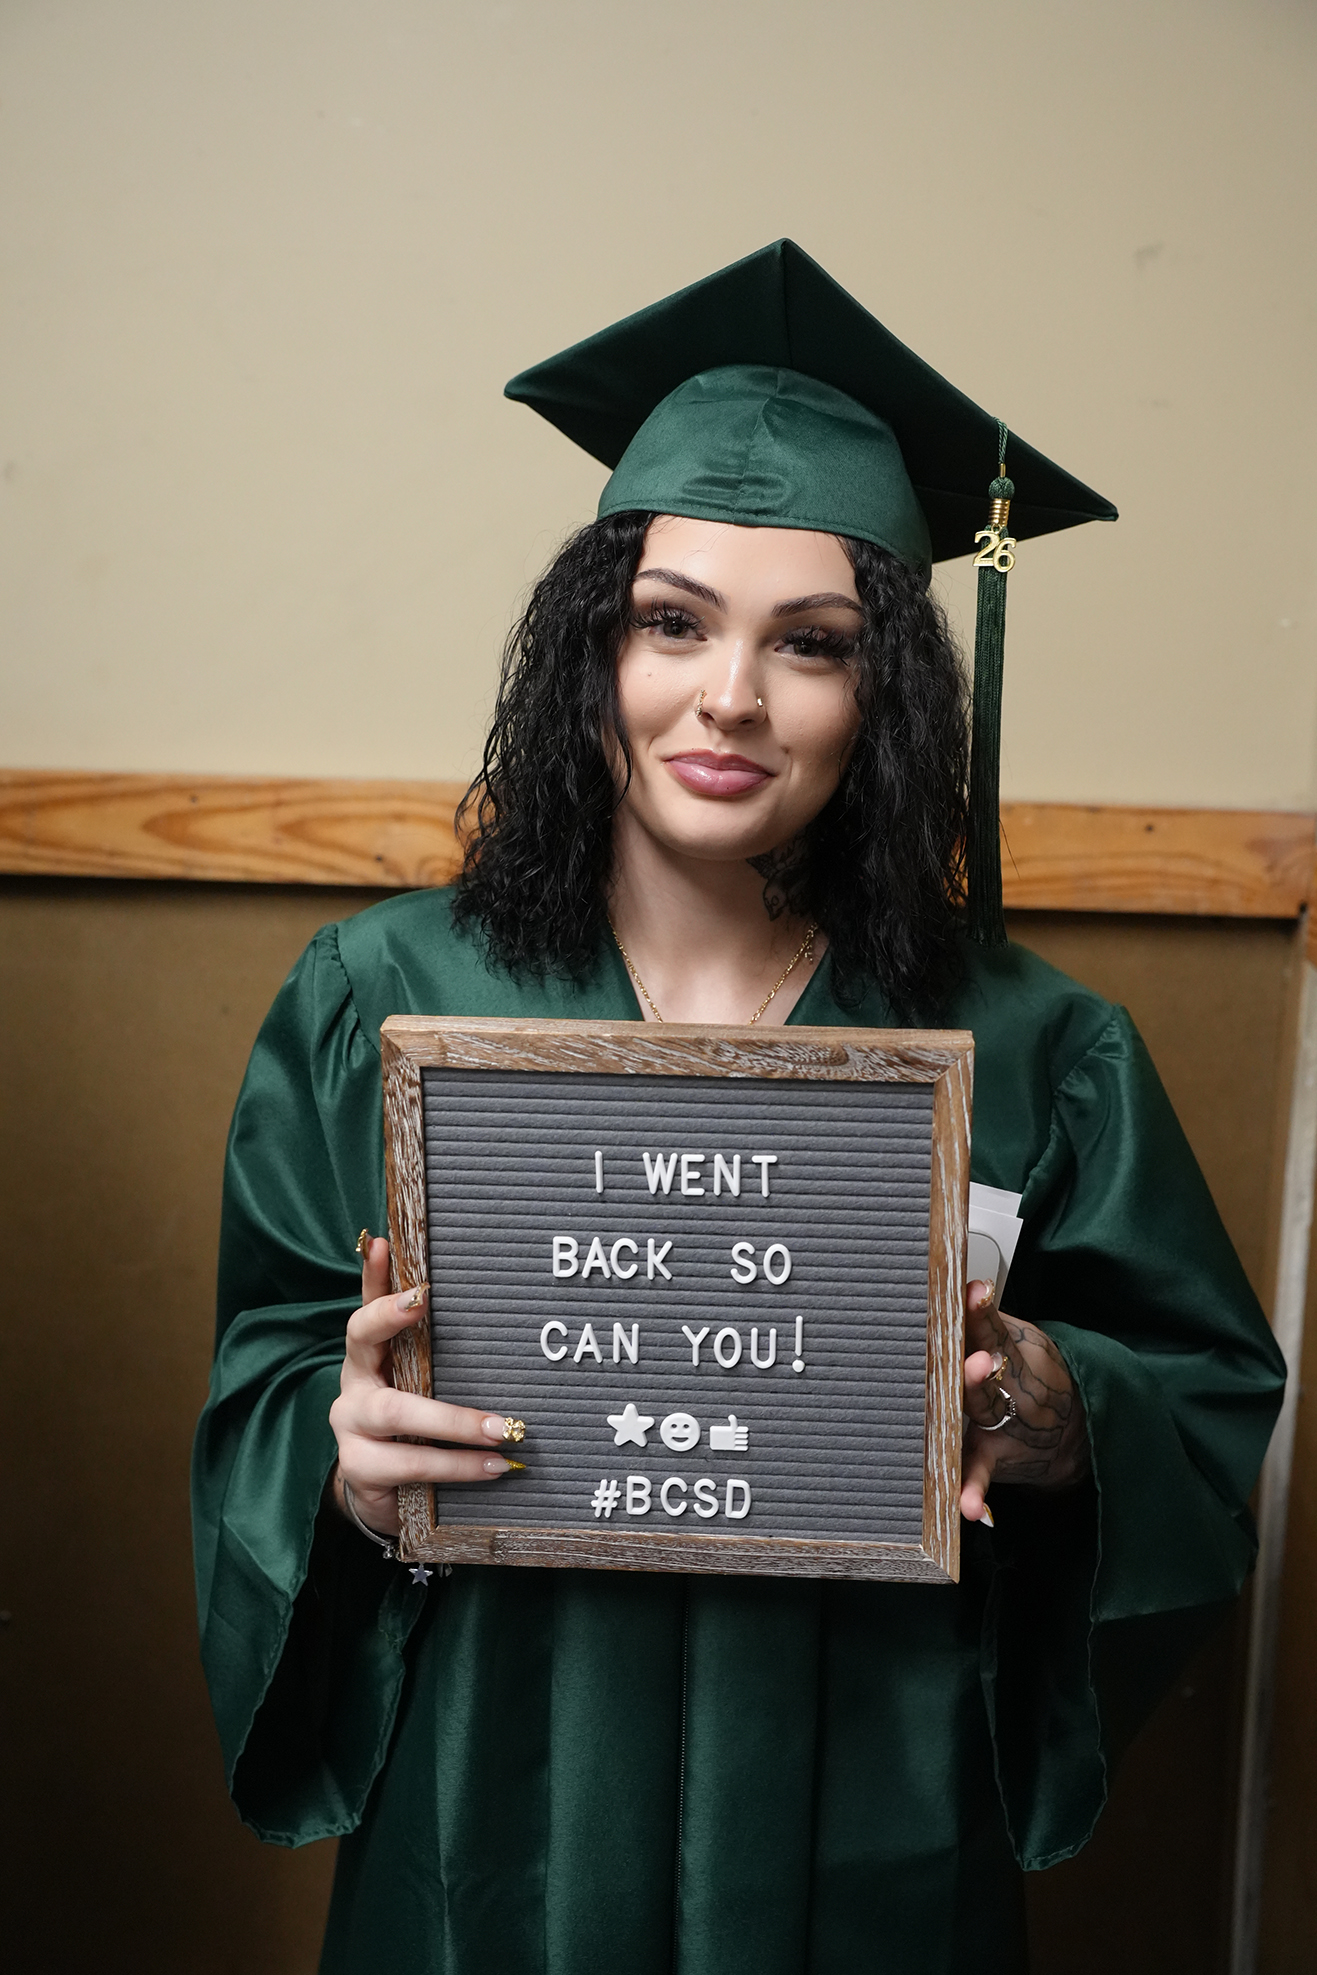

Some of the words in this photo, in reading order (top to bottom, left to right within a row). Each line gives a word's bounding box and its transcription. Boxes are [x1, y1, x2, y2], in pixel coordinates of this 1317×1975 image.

[972, 530, 1017, 573] 26
[594, 1150, 604, 1194] I
[642, 1151, 778, 1198] WENT
[551, 1234, 674, 1281] BACK
[730, 1241, 792, 1286] SO
[539, 1319, 641, 1365] CAN
[681, 1315, 806, 1373] YOU!
[589, 1474, 752, 1520] #BCSD
